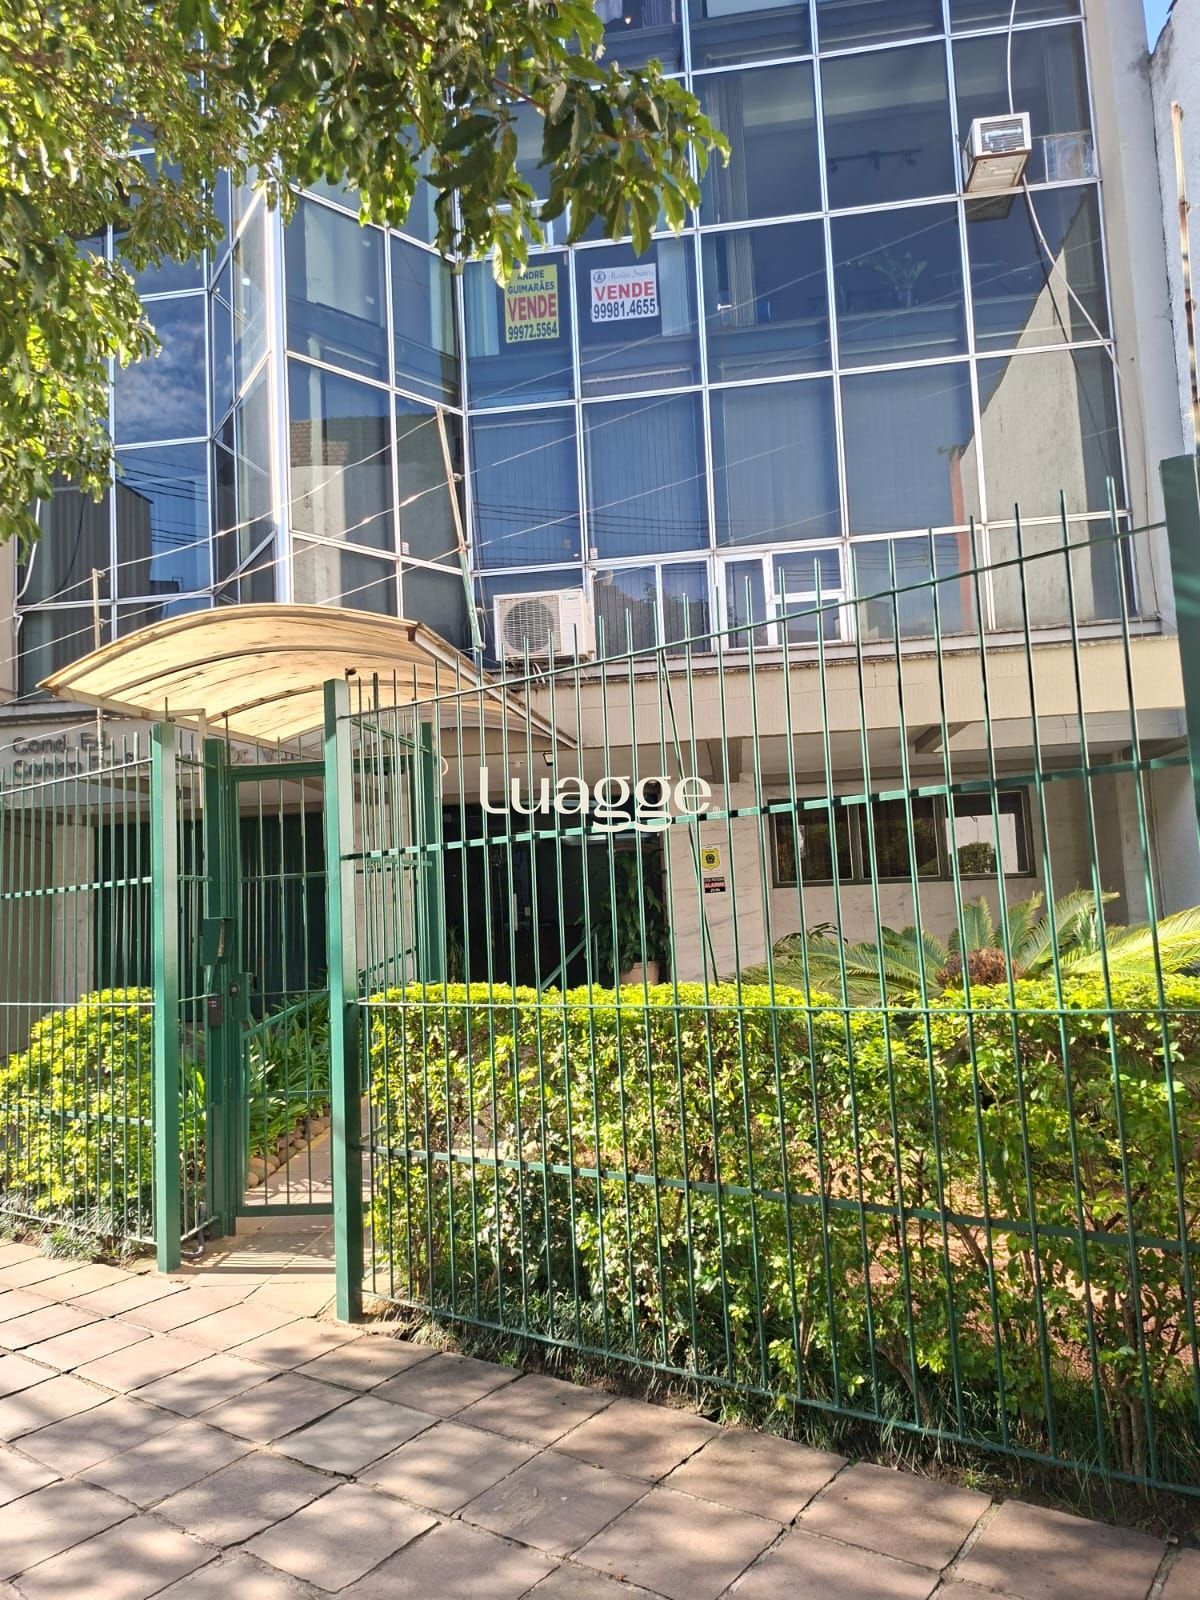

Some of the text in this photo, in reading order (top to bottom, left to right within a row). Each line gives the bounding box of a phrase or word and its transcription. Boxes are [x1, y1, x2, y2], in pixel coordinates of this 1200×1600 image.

[508, 280, 555, 295] GUIMARÃES
[594, 281, 655, 302] VENDE
[507, 293, 557, 322] VENDE
[593, 298, 656, 320] 99981.4655
[508, 320, 558, 341] 99972.5564
